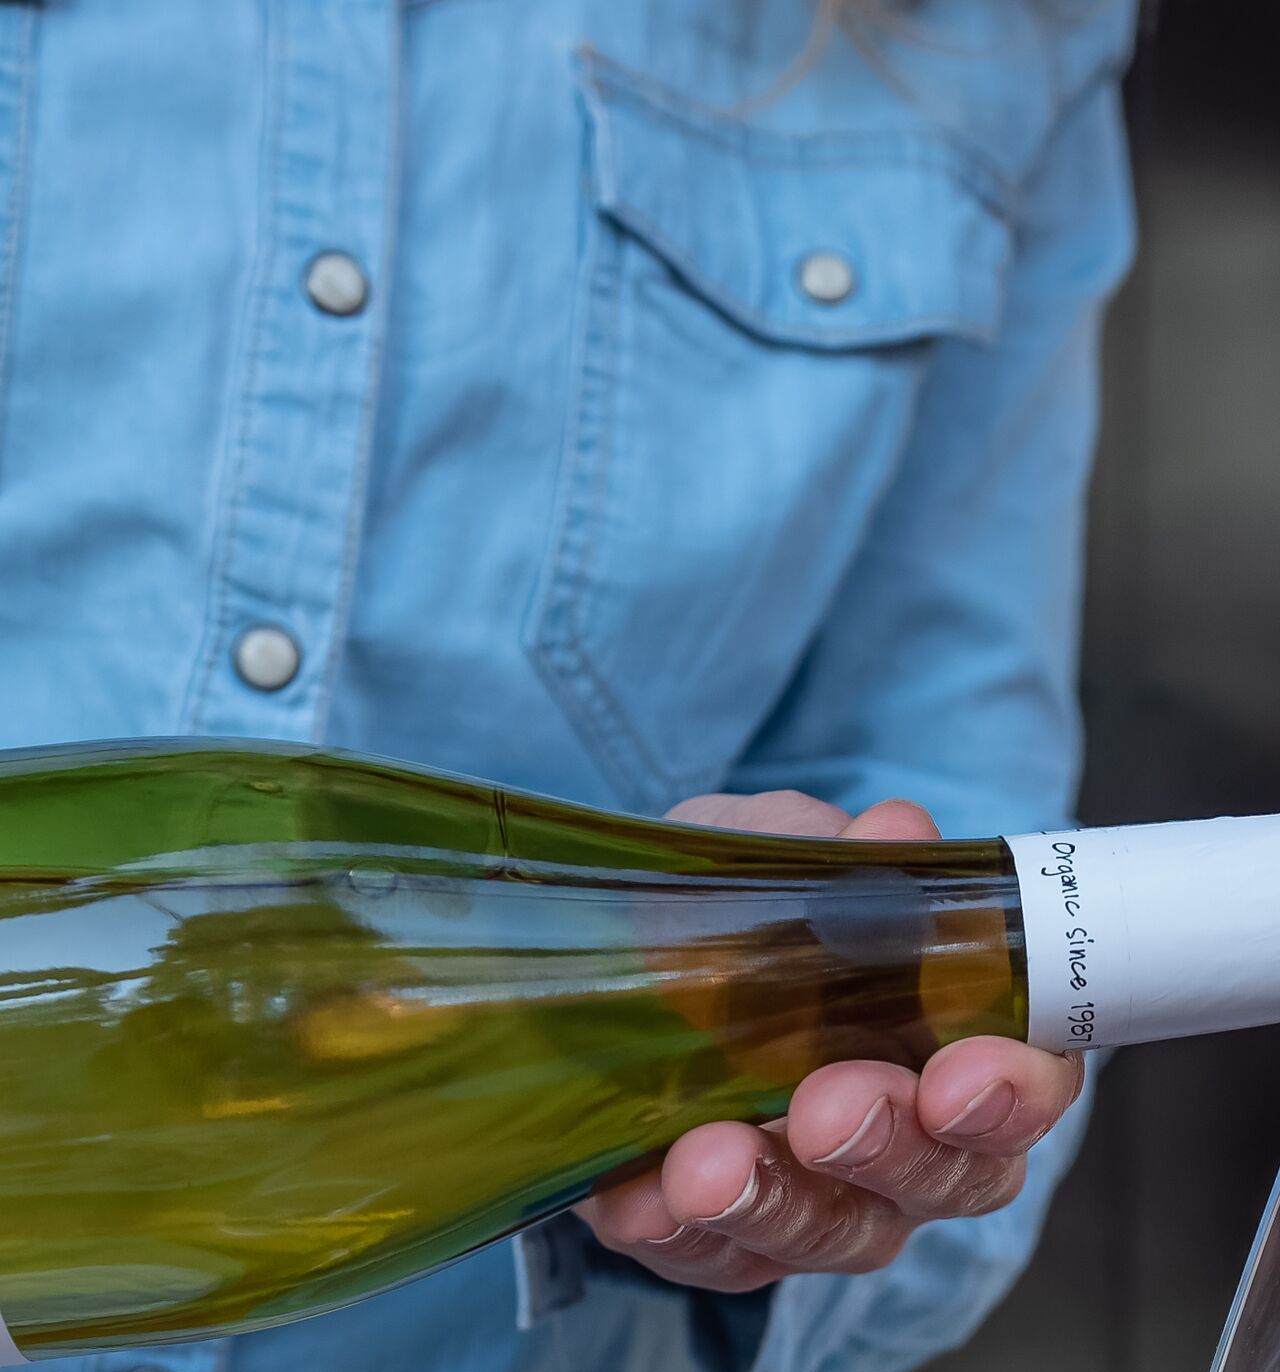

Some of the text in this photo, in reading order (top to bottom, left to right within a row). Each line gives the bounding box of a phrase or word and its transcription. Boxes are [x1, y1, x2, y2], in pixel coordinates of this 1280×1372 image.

[1041, 842, 1095, 1042] Organic since 1987
